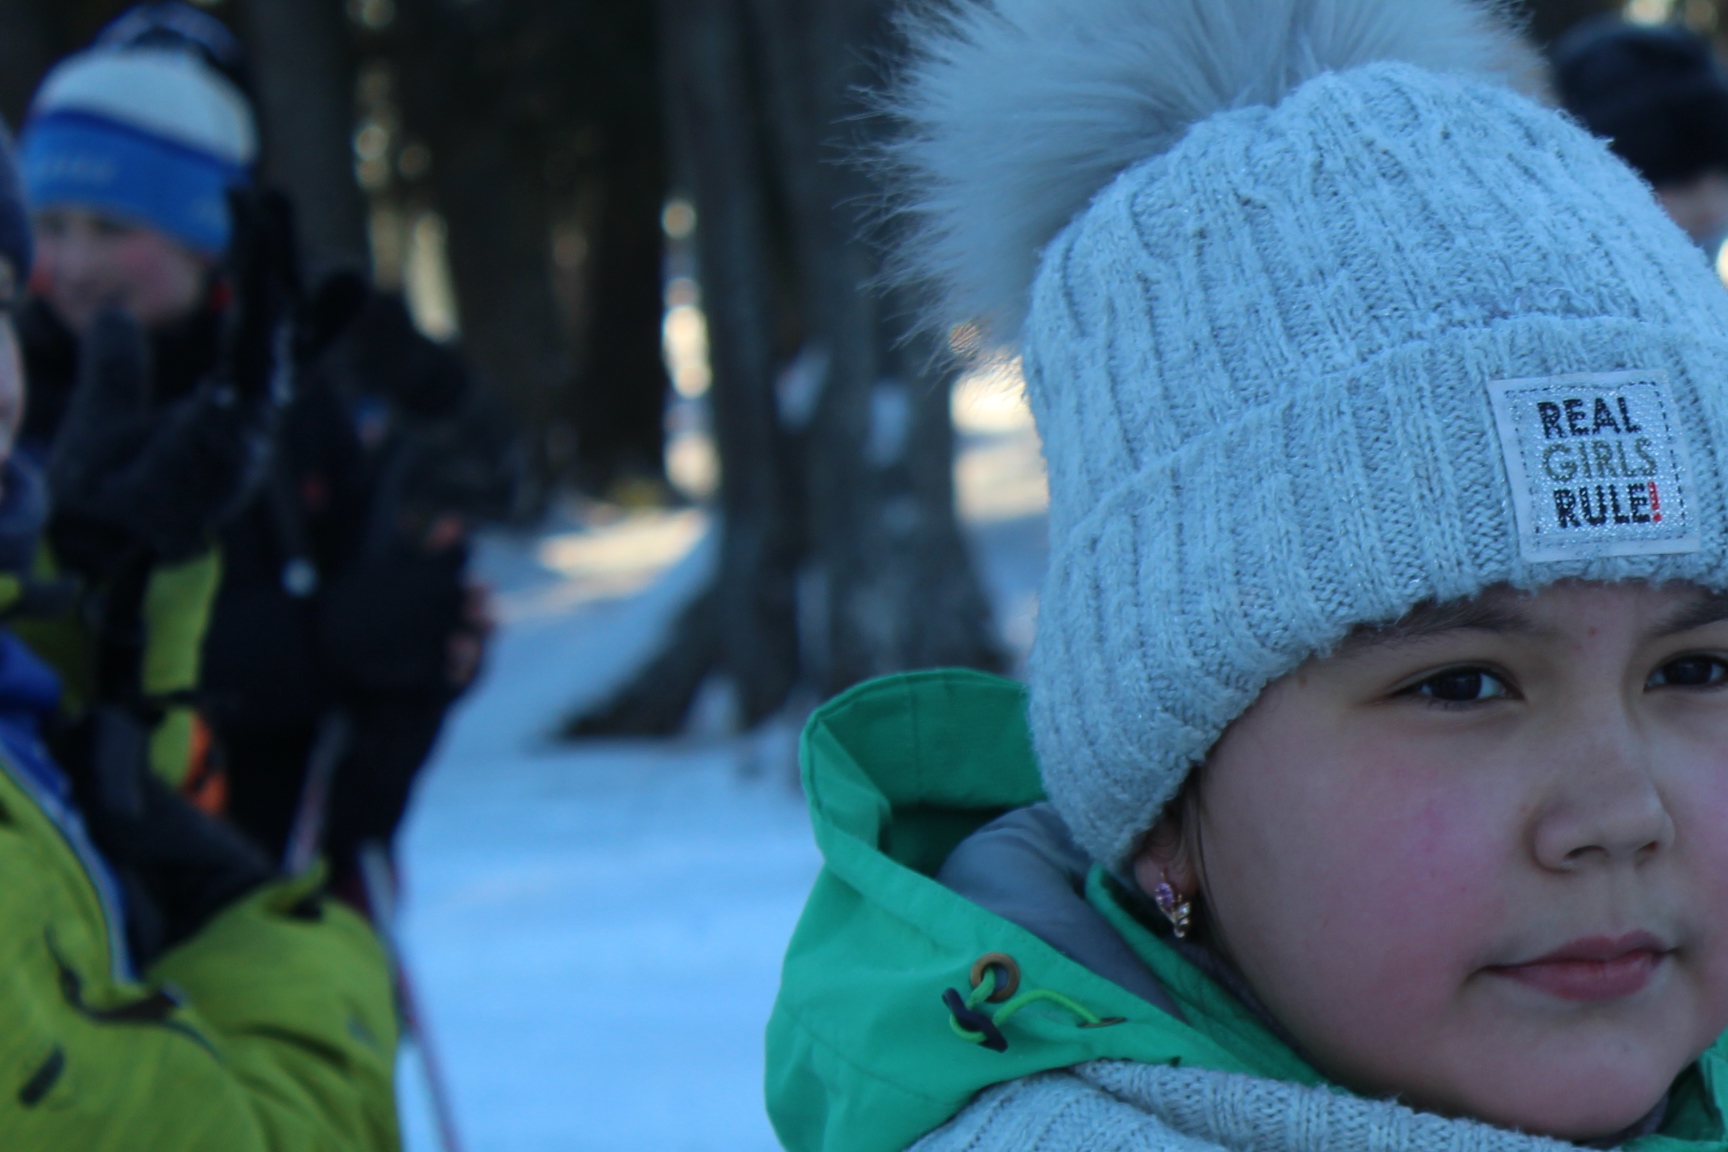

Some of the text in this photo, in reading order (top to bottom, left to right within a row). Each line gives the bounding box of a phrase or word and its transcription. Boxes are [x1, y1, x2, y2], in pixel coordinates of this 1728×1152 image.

[1537, 396, 1642, 439] REAL
[1542, 436, 1658, 483] GIRLS
[1553, 481, 1662, 529] RULE!
